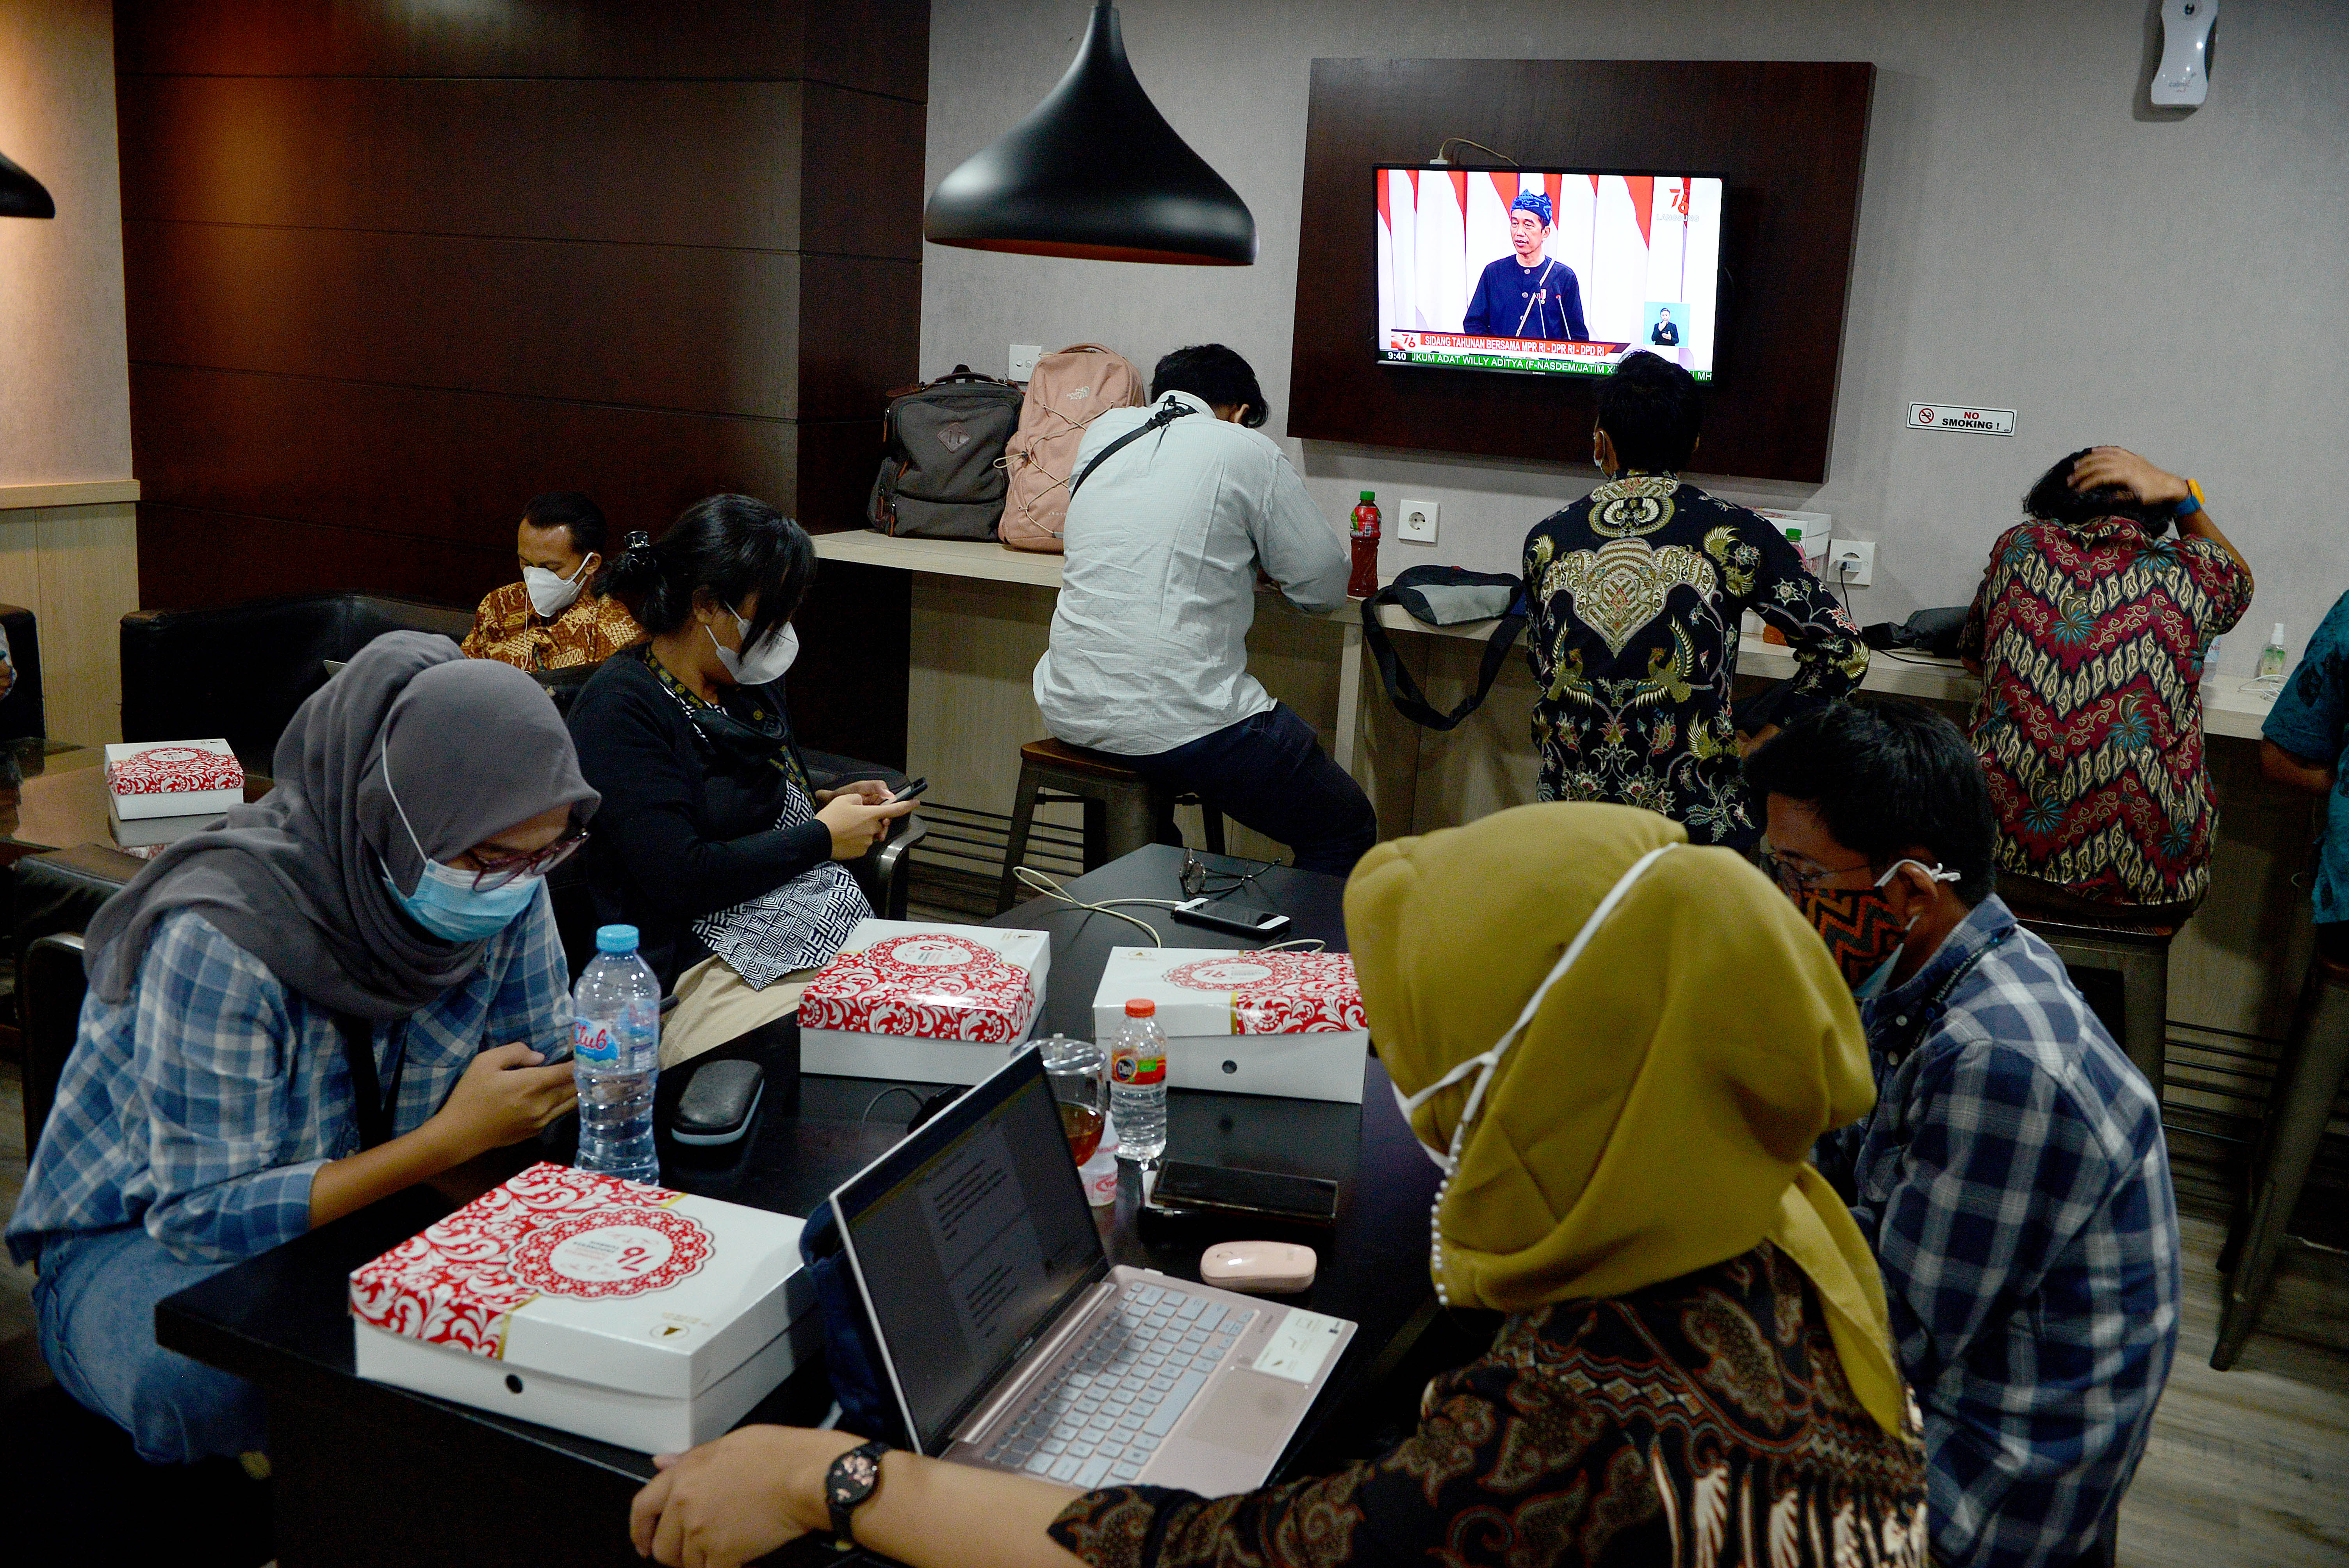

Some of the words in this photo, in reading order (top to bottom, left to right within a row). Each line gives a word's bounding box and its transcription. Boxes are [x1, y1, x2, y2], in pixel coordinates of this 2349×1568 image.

[1402, 334, 1416, 347] 76
[1425, 335, 1451, 346] SIDANG
[1452, 337, 1484, 348] TAHUNAN
[1486, 339, 1520, 351] BERSAMA
[1522, 341, 1537, 352] MPR
[1538, 342, 1546, 352] RI
[1551, 343, 1566, 353] DPR
[1567, 344, 1575, 354] RI
[1581, 345, 1595, 355] DPD
[1597, 346, 1604, 356] RI
[1388, 351, 1406, 361] 9:40
[1437, 354, 1461, 363] ADAT
[1462, 356, 1489, 365] WILLY
[1491, 358, 1523, 368] ADITYA
[1526, 360, 1604, 373] (F-NASDEM/JATIM
[1964, 412, 1979, 420] NO
[1942, 418, 1993, 429] SMOKING
